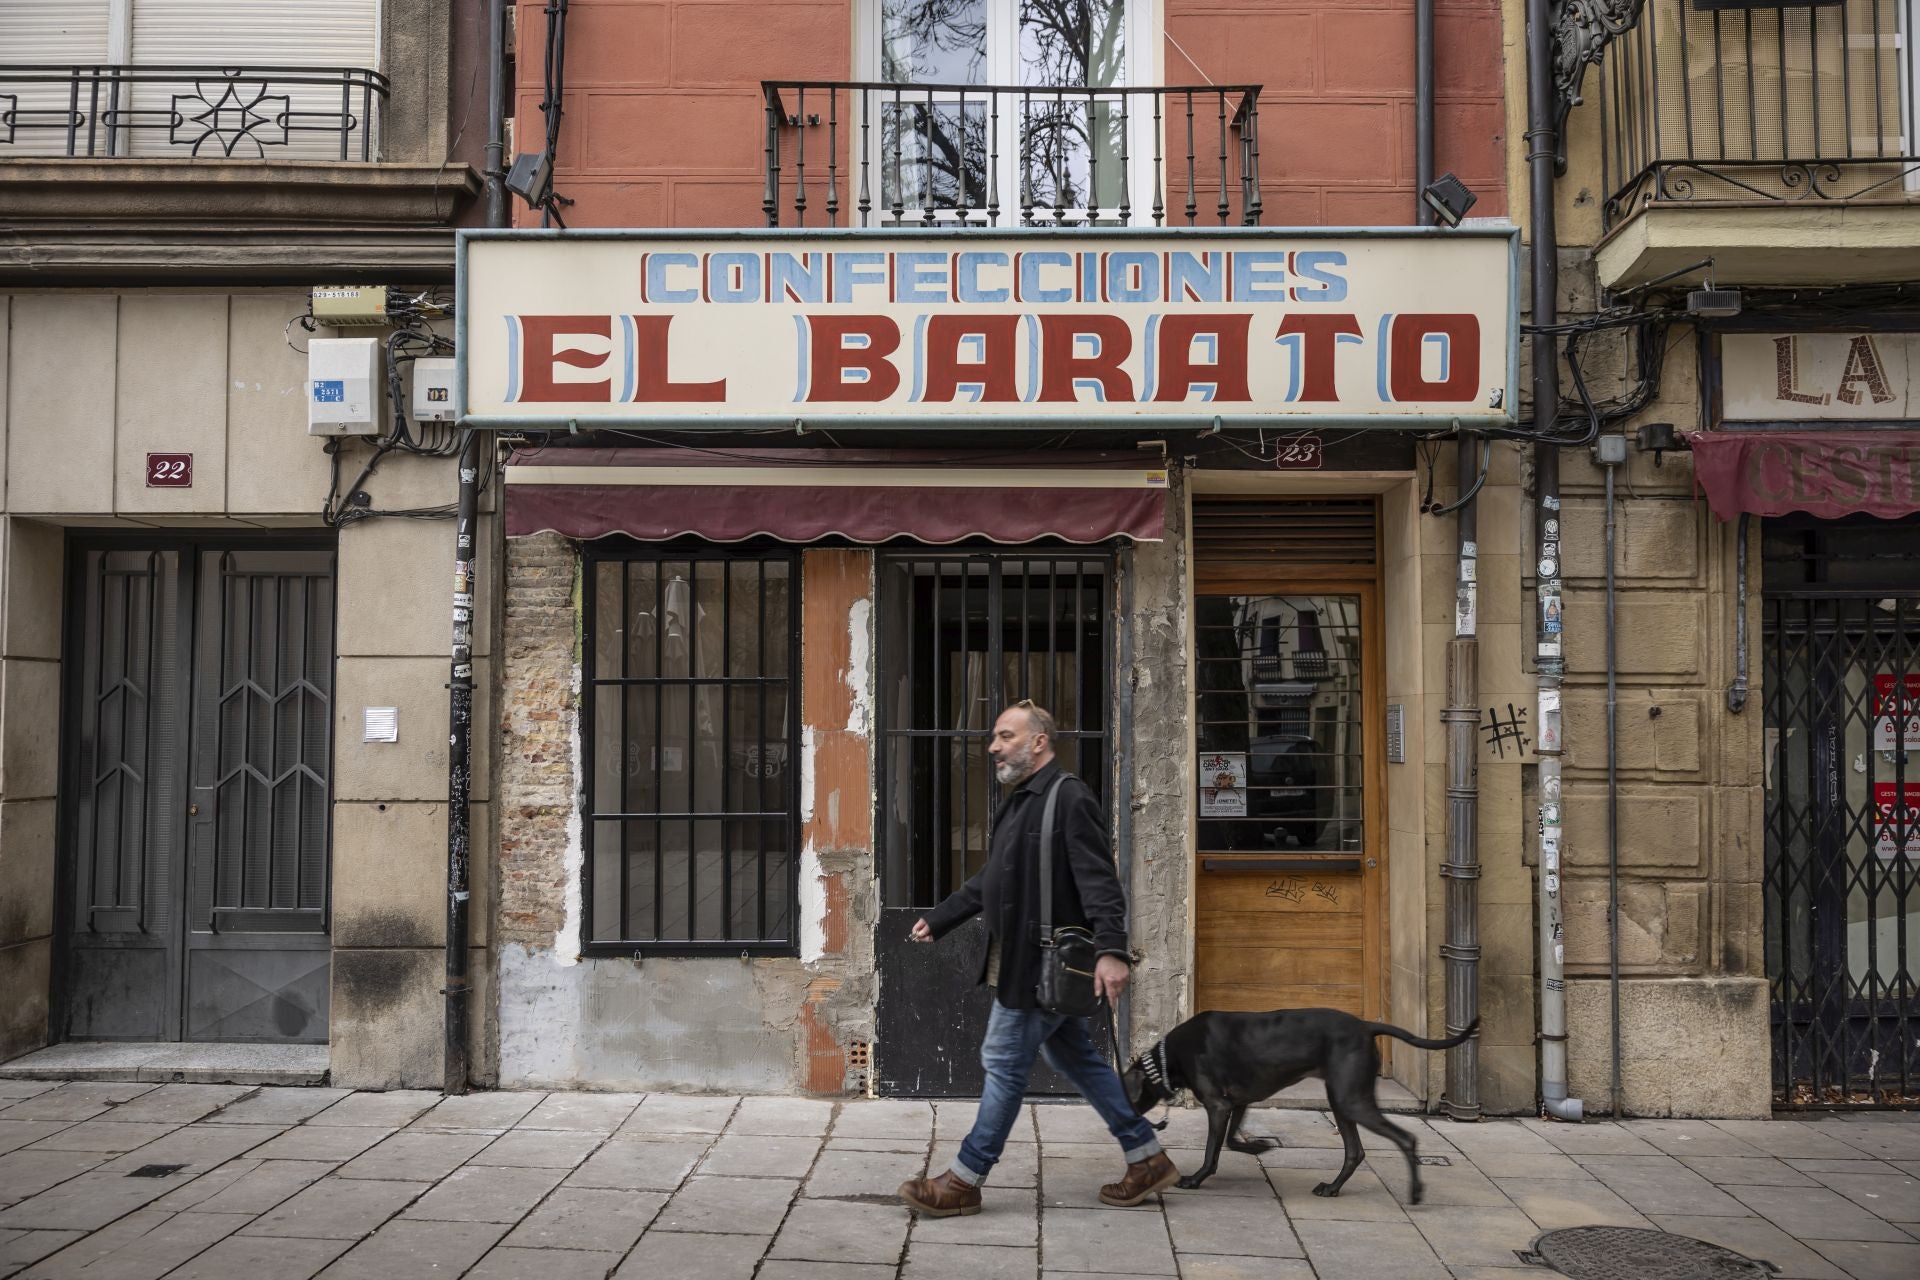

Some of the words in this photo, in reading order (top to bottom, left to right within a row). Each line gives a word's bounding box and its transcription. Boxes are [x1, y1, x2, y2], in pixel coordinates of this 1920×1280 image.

[641, 251, 1348, 304] CONFECCIONES
[503, 314, 727, 403] EL
[792, 313, 1481, 403] BARATO
[1772, 334, 1897, 406] LA
[153, 461, 186, 479] 22
[1283, 444, 1315, 462] 23
